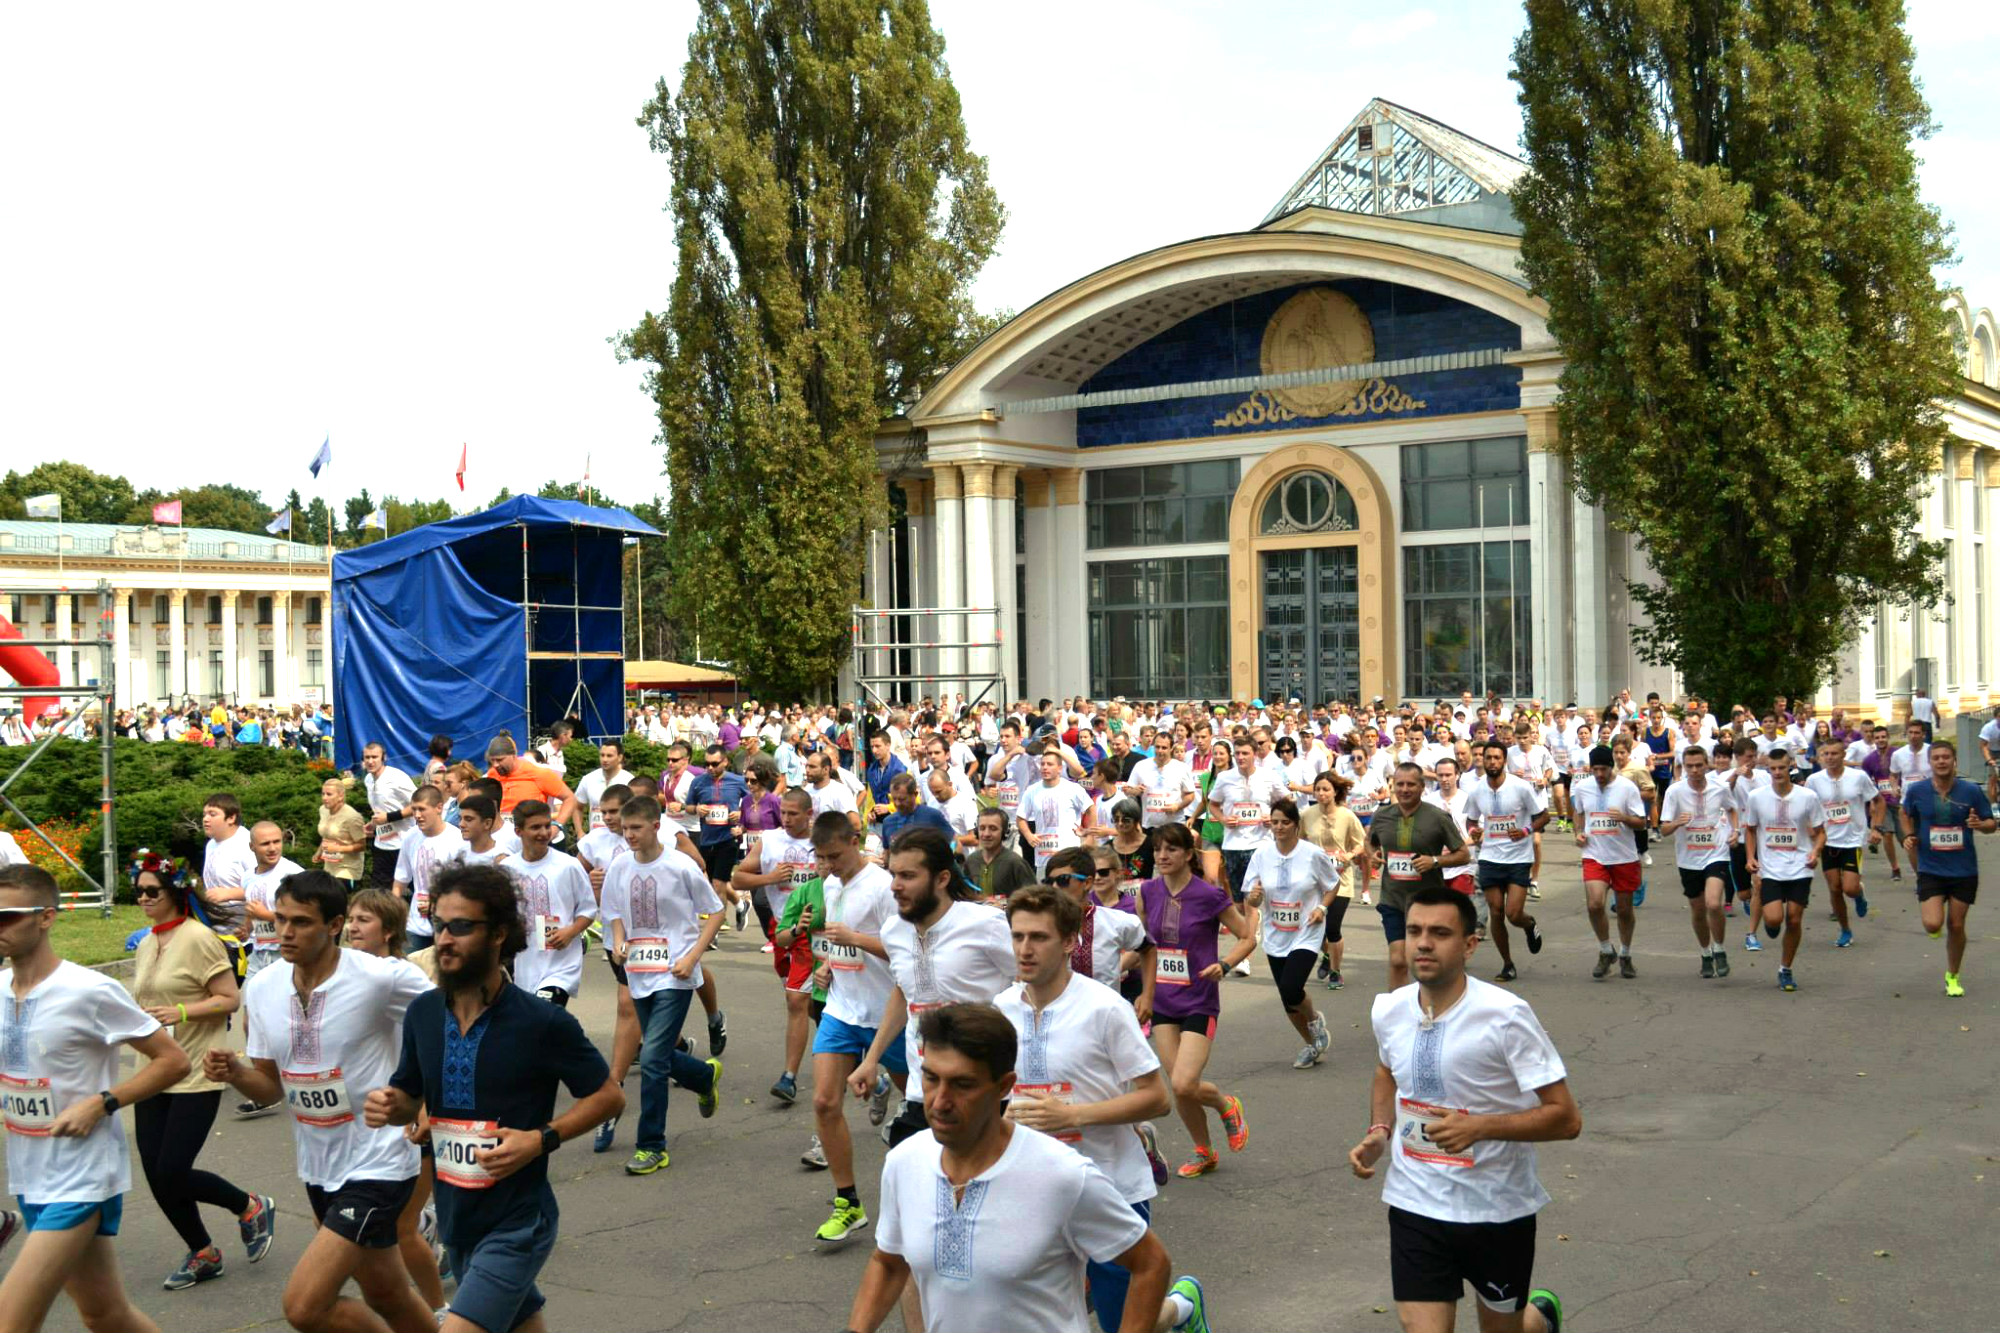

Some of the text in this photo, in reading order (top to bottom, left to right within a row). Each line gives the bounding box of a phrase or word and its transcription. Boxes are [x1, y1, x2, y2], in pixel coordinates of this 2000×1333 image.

[1241, 810, 1257, 818] 647
[1831, 808, 1847, 817] 700
[1695, 834, 1712, 843] 562
[1775, 835, 1792, 843] 699
[1940, 834, 1958, 843] 658
[1275, 911, 1299, 922] 1218
[639, 949, 669, 961] 1494
[1163, 959, 1184, 973] 668
[299, 1088, 339, 1109] 680
[9, 1094, 50, 1116] 1041
